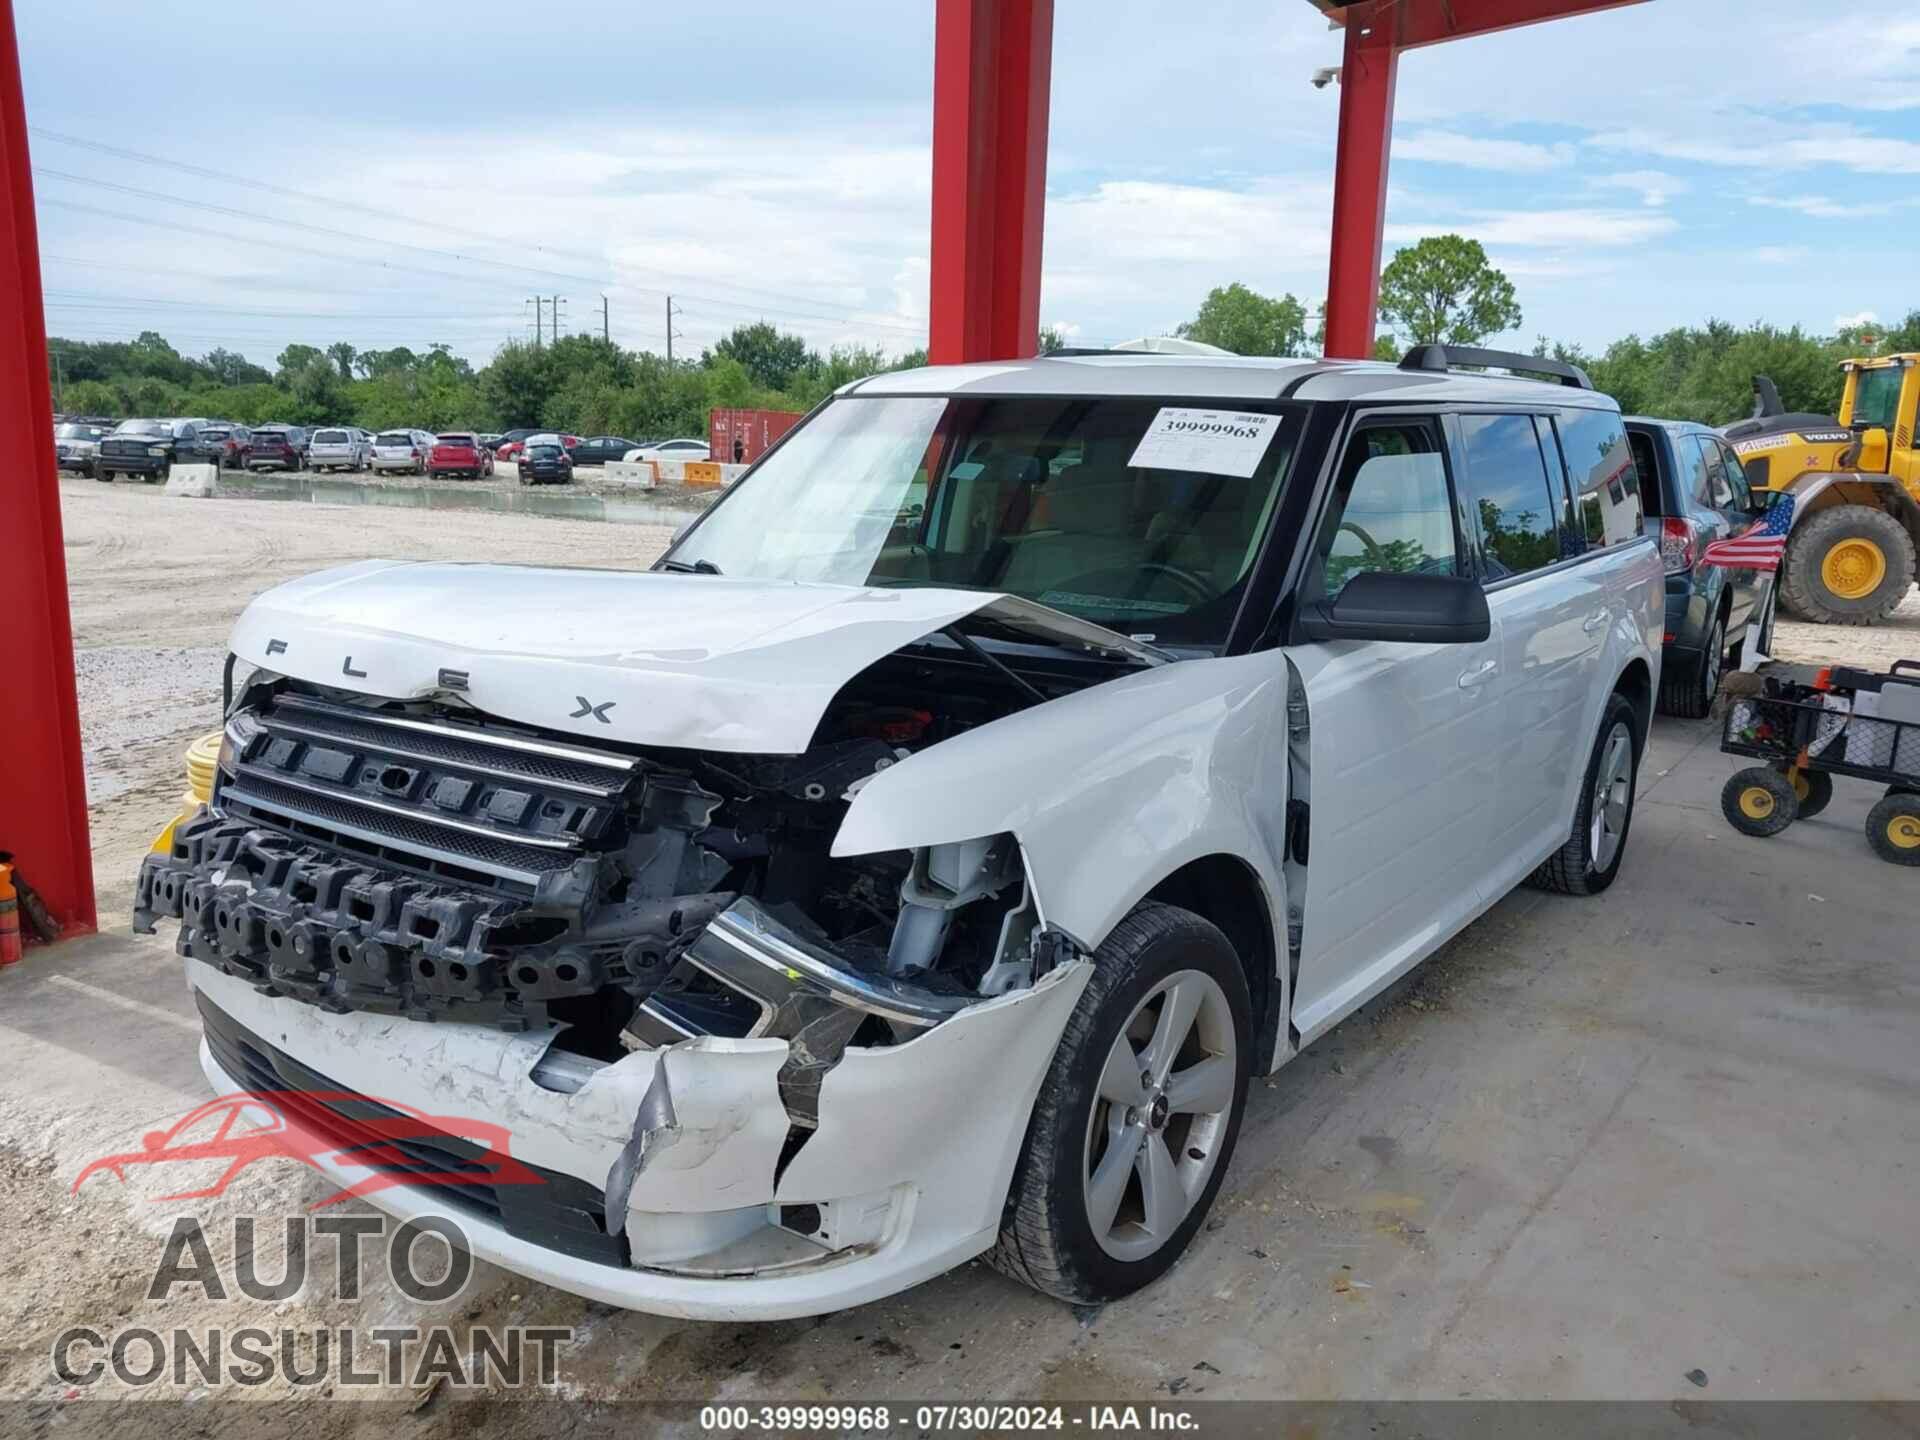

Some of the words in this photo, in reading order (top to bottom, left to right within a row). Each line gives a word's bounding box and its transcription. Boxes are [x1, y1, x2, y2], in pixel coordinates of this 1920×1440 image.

[1160, 420, 1260, 438] 39999968
[1805, 433, 1848, 441] VOLVO
[265, 638, 617, 725] FLEX
